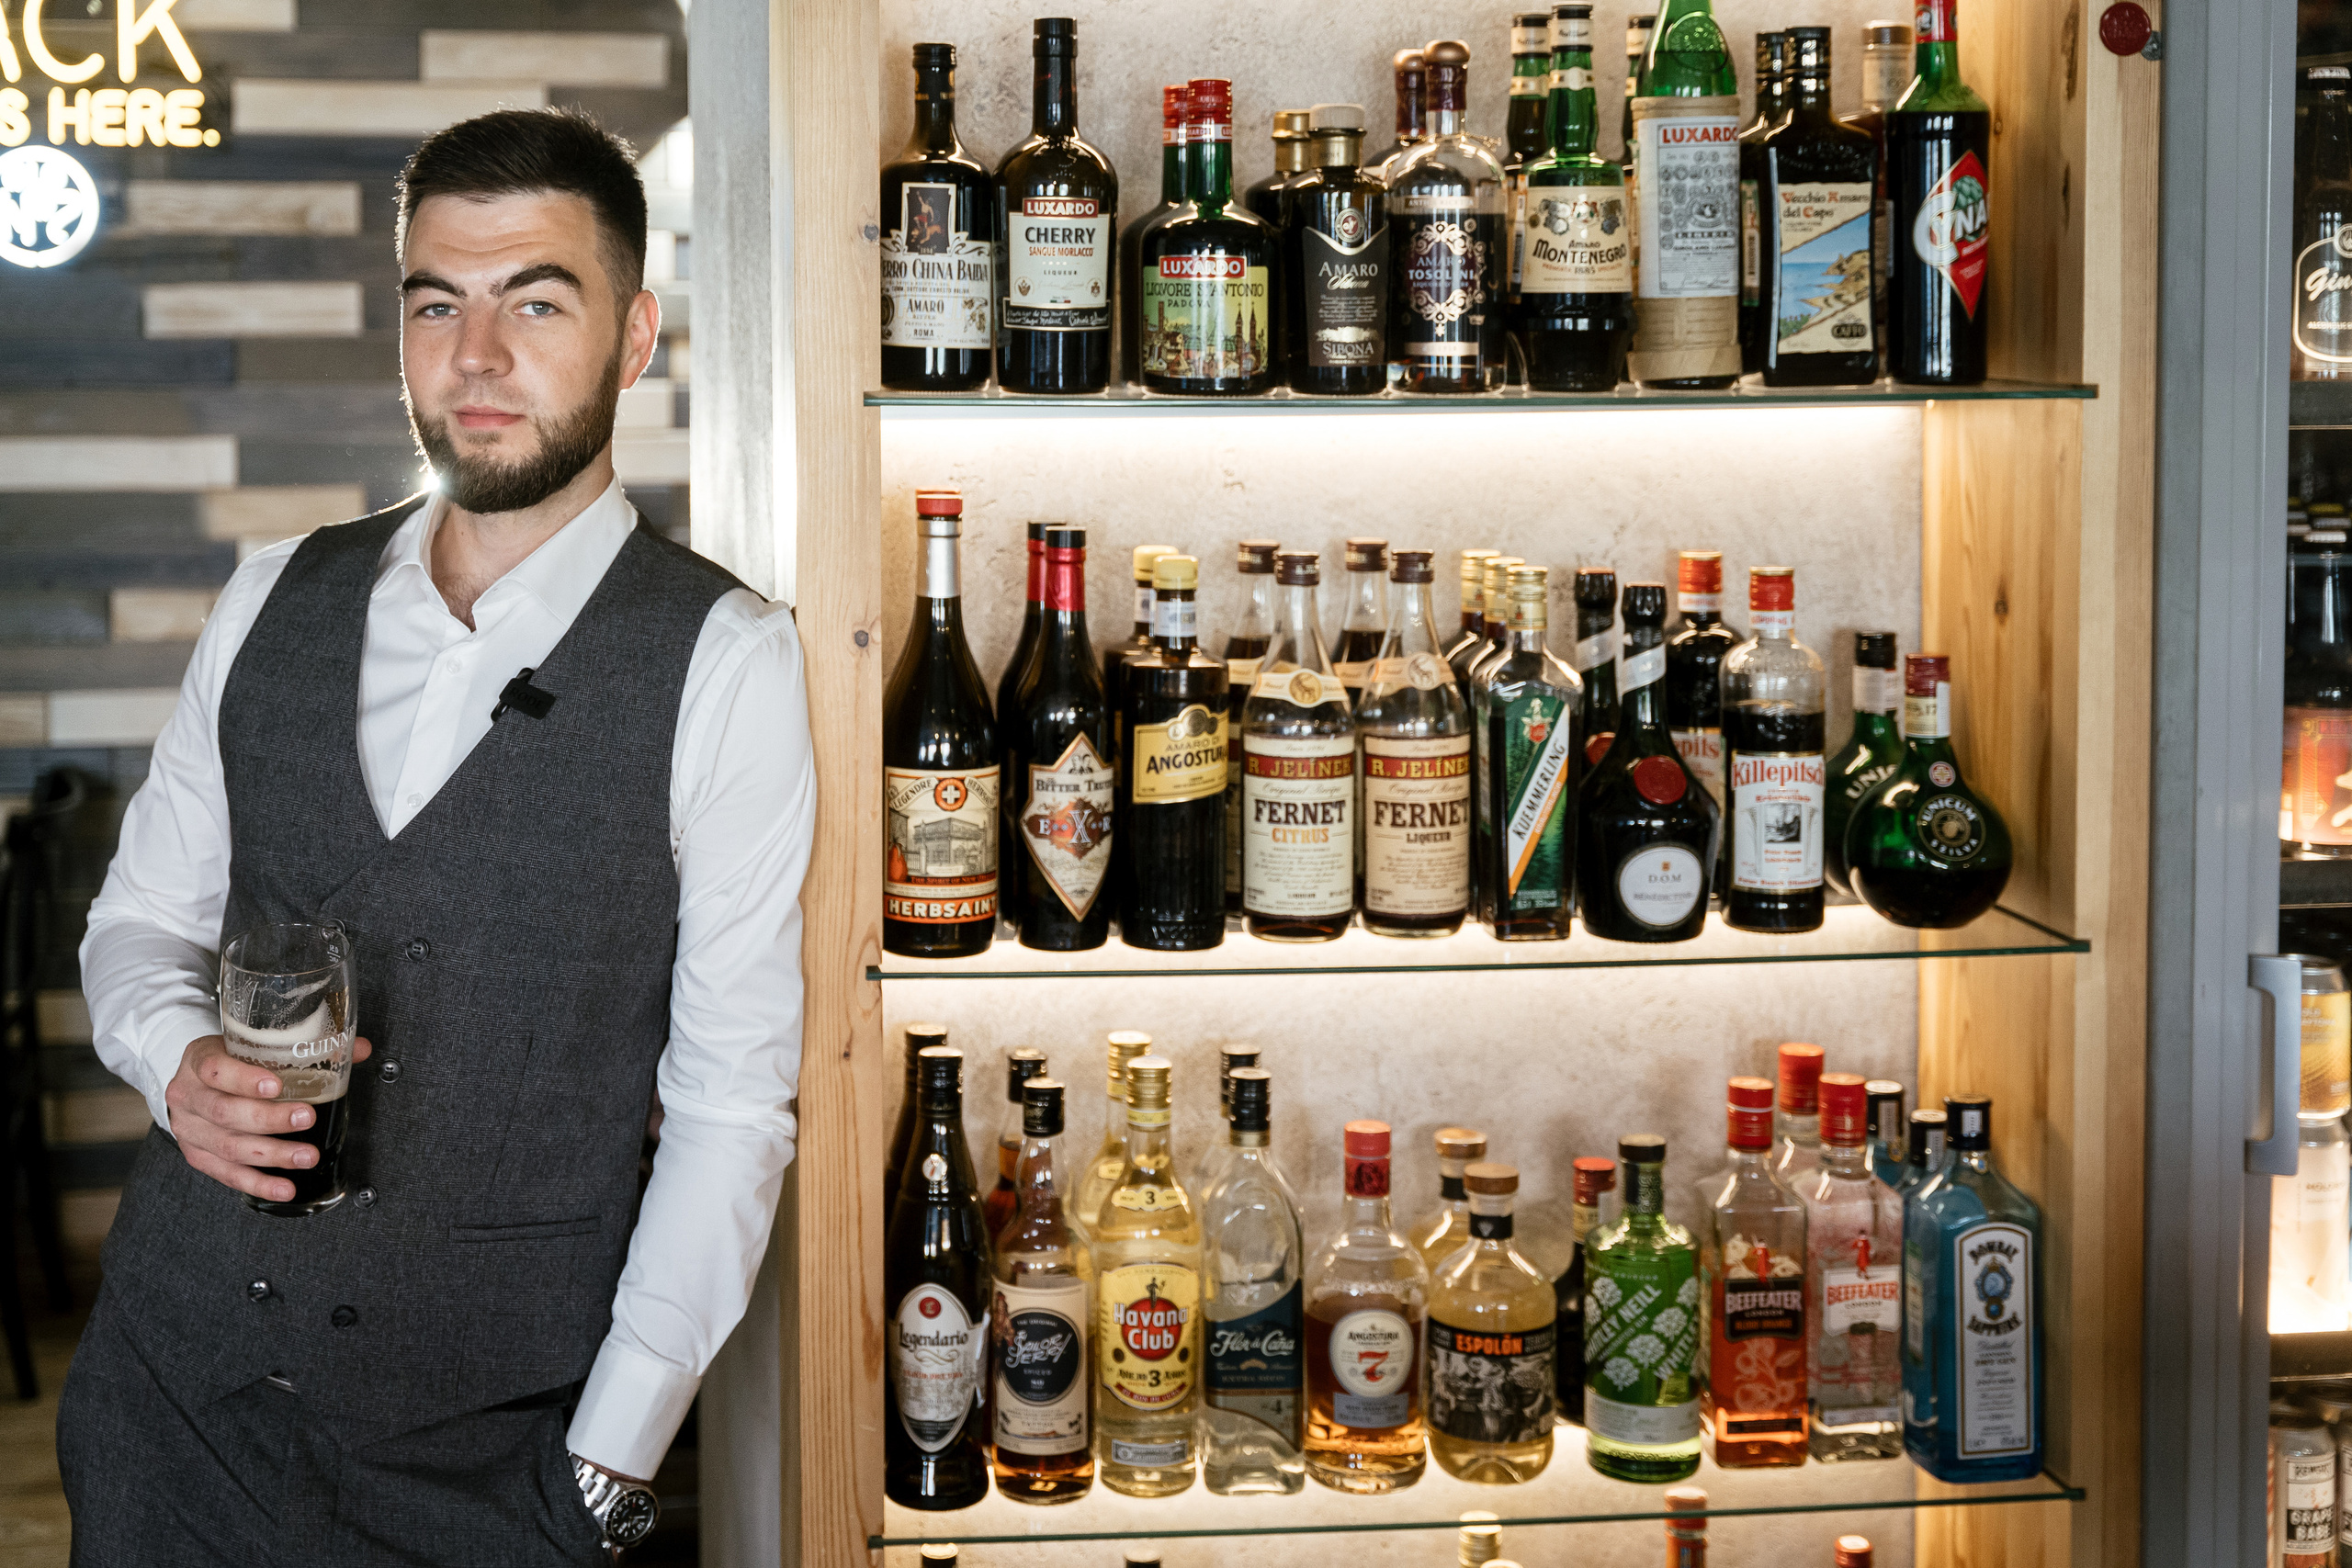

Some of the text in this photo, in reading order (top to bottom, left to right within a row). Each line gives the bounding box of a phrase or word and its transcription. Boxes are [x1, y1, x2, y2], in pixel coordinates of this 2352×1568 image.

[48, 86, 220, 148] HERE.
[1026, 201, 1095, 215] LUXARDO
[1781, 191, 1870, 204] Vecchio Amaro
[1782, 206, 1834, 220] del Capo
[1024, 226, 1096, 244] CHERRY
[1912, 190, 1990, 266] CYNA
[1029, 246, 1094, 257] SANGUE MORLACCO
[1416, 257, 1466, 266] AMARO
[1532, 239, 1627, 265] MONTENEGRO
[882, 260, 908, 278] ERRO
[912, 258, 953, 280] CHINA
[1162, 260, 1241, 276] LUXARDO
[1318, 261, 1378, 276] AMARO
[1408, 269, 1475, 280] TOSOLNI
[907, 299, 944, 313] AMARO
[1168, 299, 1211, 308] PADOVA
[913, 329, 934, 337] ROMA
[1146, 746, 1227, 773] ANGOSTUR
[1249, 756, 1351, 778] R. JELÍNEK
[1372, 759, 1391, 776] R.
[892, 778, 933, 809] LEGENDRE
[1512, 738, 1566, 840] KUEMMERLING
[1254, 798, 1346, 826] FERNET
[1374, 799, 1469, 829] FERNET
[1922, 797, 1977, 821] UNICUM
[1272, 828, 1329, 843] CITRUS
[1407, 831, 1451, 844] LIQUEUR
[1930, 839, 1978, 856] SZILVA
[888, 898, 996, 919] HERBSAINT
[1146, 1190, 1156, 1205] 3
[1968, 1241, 2020, 1265] BOMBAY
[1617, 1283, 1663, 1324] NEILL
[1725, 1291, 1803, 1314] BEEFEATER
[1826, 1281, 1899, 1306] BEEFEATER
[1114, 1303, 1188, 1328] Havana
[899, 1324, 969, 1352] Legendario
[1128, 1328, 1175, 1350] Club
[1209, 1329, 1250, 1357] Flor
[1261, 1329, 1295, 1357] Caña
[1455, 1333, 1522, 1355] ESPOLÓN
[1357, 1350, 1389, 1382] 7
[1148, 1371, 1161, 1388] 3
